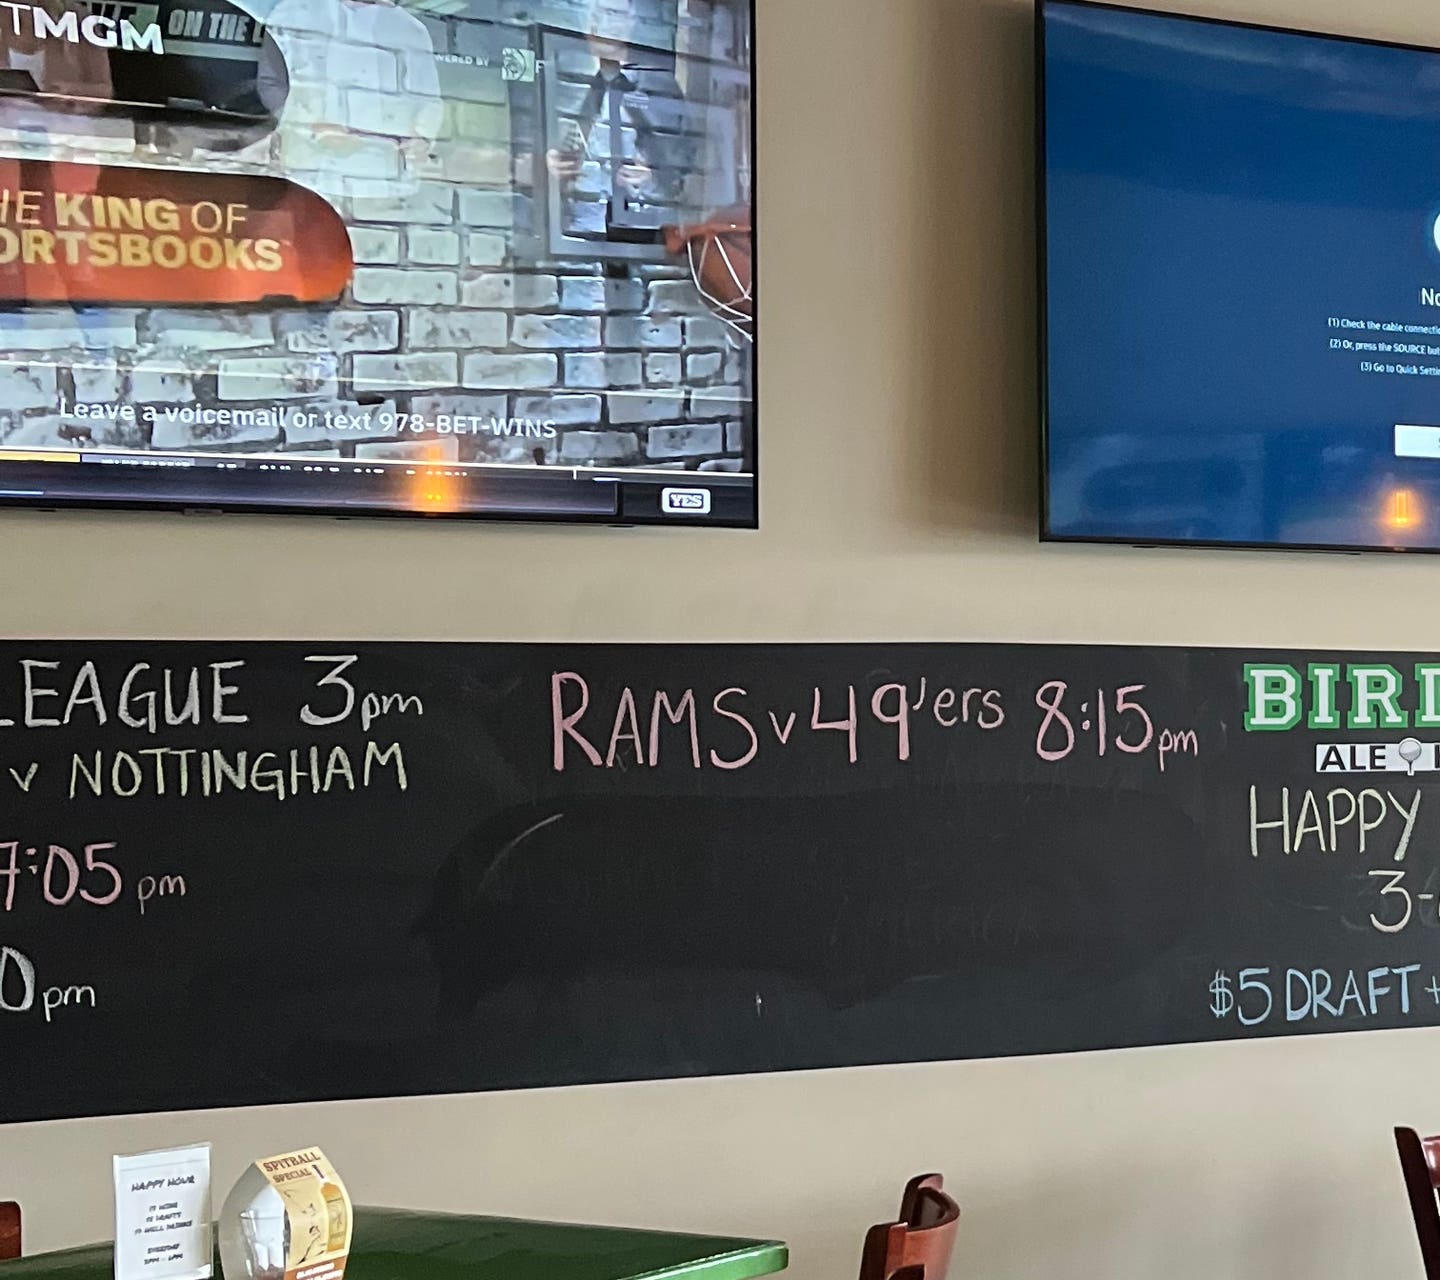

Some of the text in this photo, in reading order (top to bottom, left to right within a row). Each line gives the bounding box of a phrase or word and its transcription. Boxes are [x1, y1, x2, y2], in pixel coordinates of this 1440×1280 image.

[54, 192, 181, 231] KING
[190, 200, 250, 234] OF
[1341, 318, 1365, 329] Check
[1367, 320, 1380, 330] the
[1382, 322, 1403, 332] cable
[1355, 342, 1377, 352] press
[1378, 342, 1392, 352] the
[1393, 343, 1426, 355] SOURCE
[1373, 362, 1385, 372] Go
[1386, 364, 1395, 373] to
[1396, 364, 1417, 375] Quick
[60, 397, 558, 439] Leave a voicemail or text 978-BET-WINS
[668, 492, 704, 509] YES
[0, 654, 424, 733] EAGUE 3pm
[553, 671, 759, 772] RAMS
[69, 742, 407, 800] NOTTINGHAM
[1319, 744, 1387, 772] ALE
[1248, 784, 1422, 862] HAPPY
[1208, 966, 1273, 1026] $5
[1285, 963, 1421, 1022] DRAFT
[263, 1152, 321, 1173] SPITBALL
[273, 1168, 312, 1184] SPECIAL
